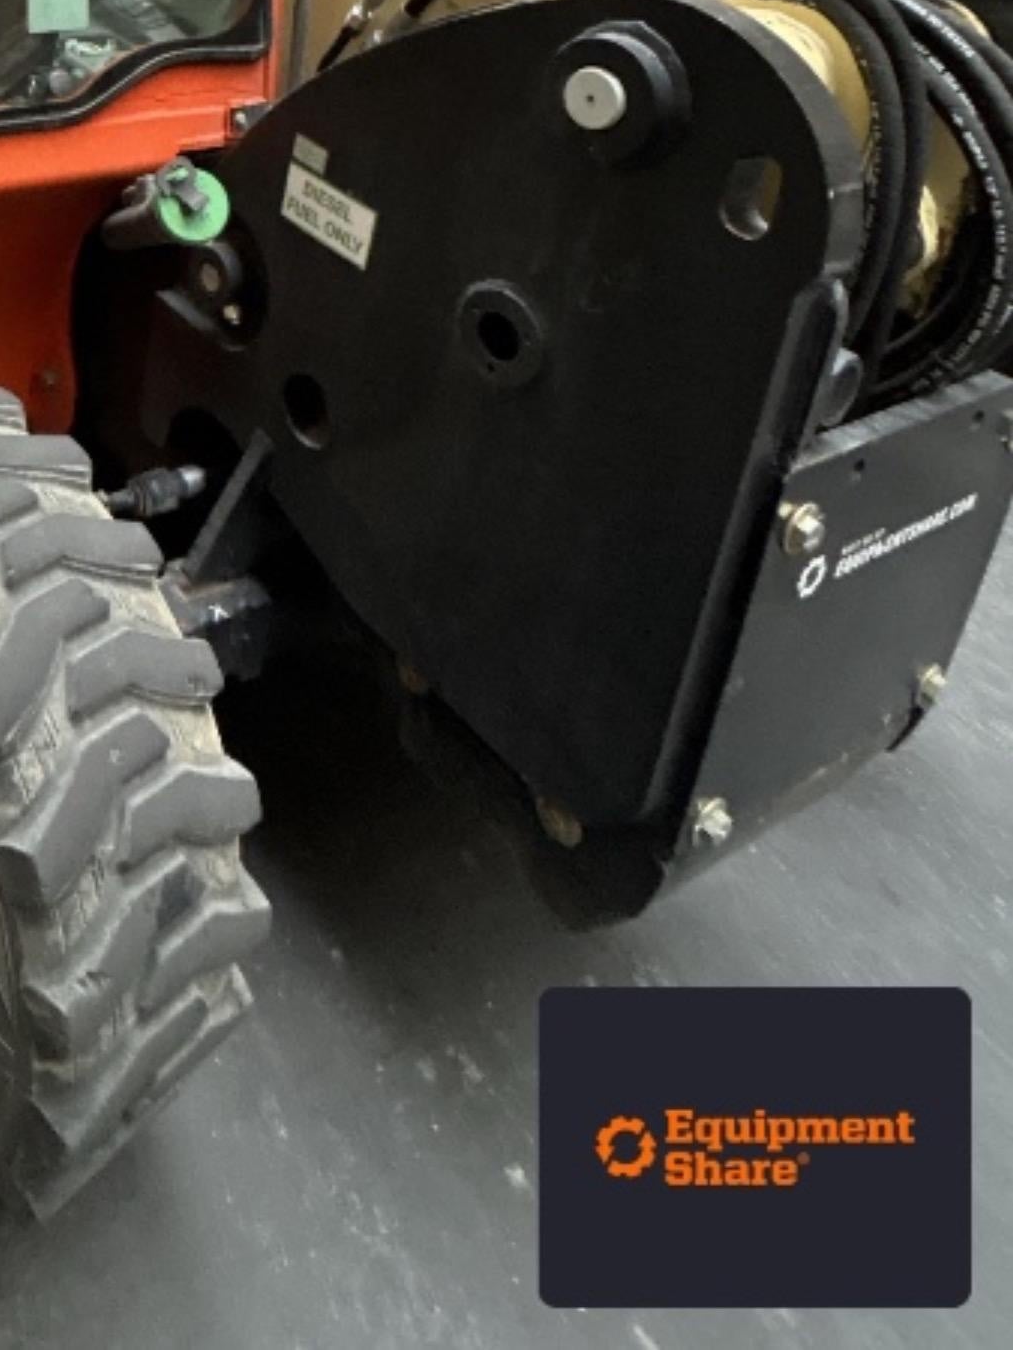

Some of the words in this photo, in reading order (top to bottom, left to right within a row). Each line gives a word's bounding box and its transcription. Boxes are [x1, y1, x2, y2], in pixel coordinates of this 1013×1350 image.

[285, 195, 320, 230] FUEL
[323, 220, 364, 255] ONLY
[302, 180, 352, 224] DIESEL
